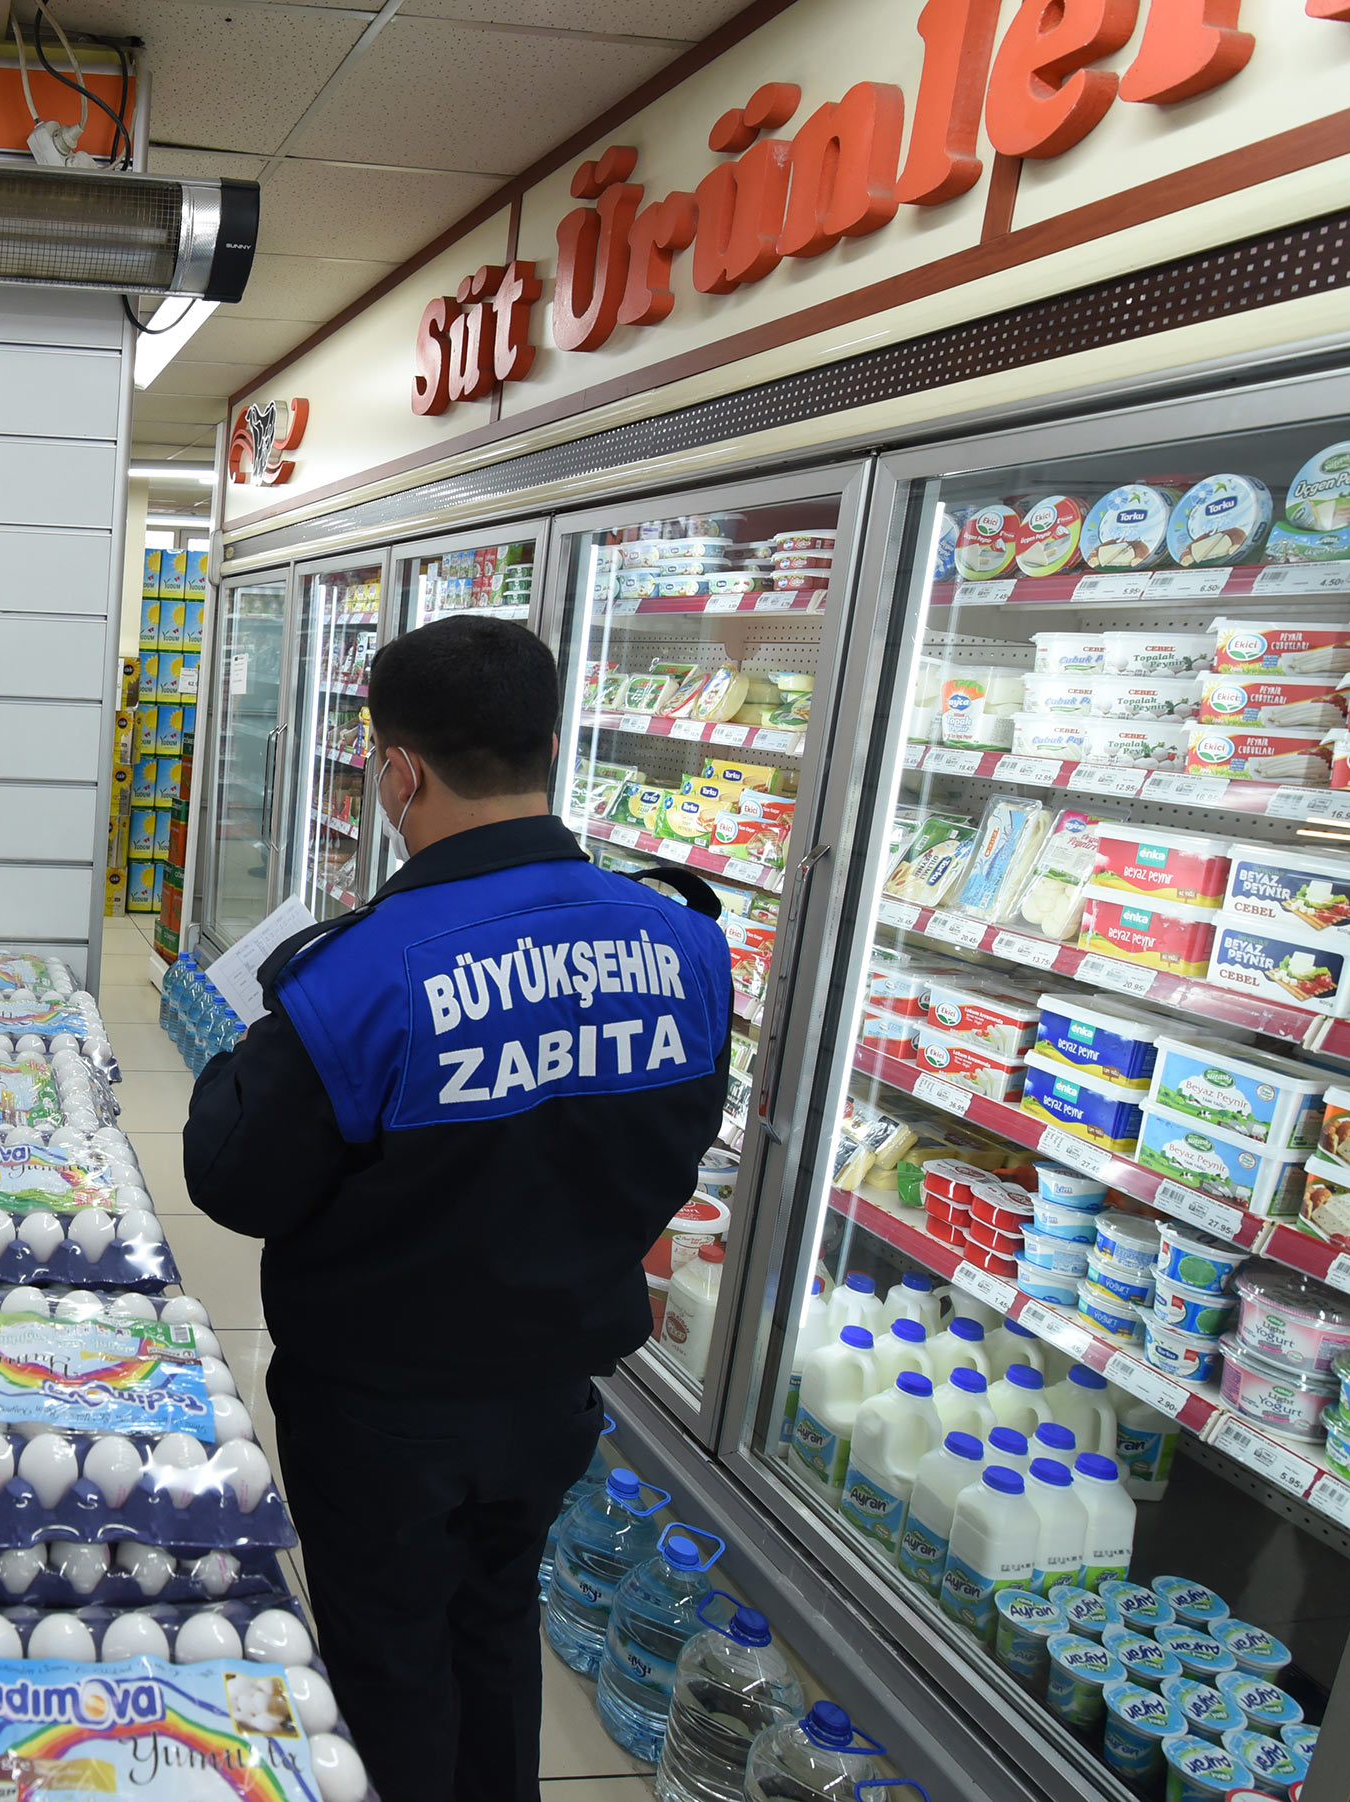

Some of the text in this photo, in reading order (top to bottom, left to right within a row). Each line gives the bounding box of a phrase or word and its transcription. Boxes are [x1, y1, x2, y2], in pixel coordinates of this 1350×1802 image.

[411, 0, 1350, 416] Süt Ürünler
[1294, 481, 1334, 498] Üçgen
[1208, 499, 1235, 514] Torku
[983, 516, 998, 526] Ekici
[1034, 512, 1051, 523] Ekici
[1120, 512, 1145, 523] Torku
[1234, 640, 1258, 649] Ekici
[1133, 653, 1175, 662] Topalak
[1117, 697, 1158, 705] Topalak
[1217, 692, 1238, 702] Ekici
[1118, 732, 1148, 740] CEBEL
[1203, 742, 1226, 751] Ekici
[744, 805, 758, 815] Ekici
[719, 824, 734, 832] Ekici
[1139, 848, 1166, 861] enka
[1238, 870, 1281, 887] BEYAZ
[1242, 882, 1291, 900] PEYNİR
[1123, 910, 1149, 924] enka
[1234, 902, 1276, 919] CEBEL
[1224, 936, 1265, 956] BEYAZ
[1227, 950, 1274, 970] PEYNİR
[423, 929, 686, 1036] BÜYÜKŞEHİR
[1219, 969, 1260, 987] CEBEL
[940, 1006, 956, 1018] Ekici
[1071, 1024, 1094, 1039] enka
[438, 1014, 687, 1104] ZABITA
[929, 1047, 945, 1060] Ekici
[1056, 1081, 1078, 1096] enka
[1185, 1080, 1248, 1109] Beyaz Peynir
[1168, 1143, 1227, 1173] Beyaz Peynir
[1262, 1320, 1288, 1336] Light
[1268, 1391, 1295, 1407] Light
[797, 1424, 825, 1445] Ayran
[1279, 1471, 1301, 1488] 5.95
[849, 1488, 888, 1513] Ayran
[903, 1532, 938, 1558] Ayran
[944, 1573, 982, 1599] Ayran
[1008, 1603, 1056, 1617] Ayran
[1063, 1648, 1110, 1667] Ayran
[1124, 1699, 1168, 1720] Ayran
[117, 1730, 309, 1786] Yumuta
[1183, 1753, 1234, 1777] Ayran
